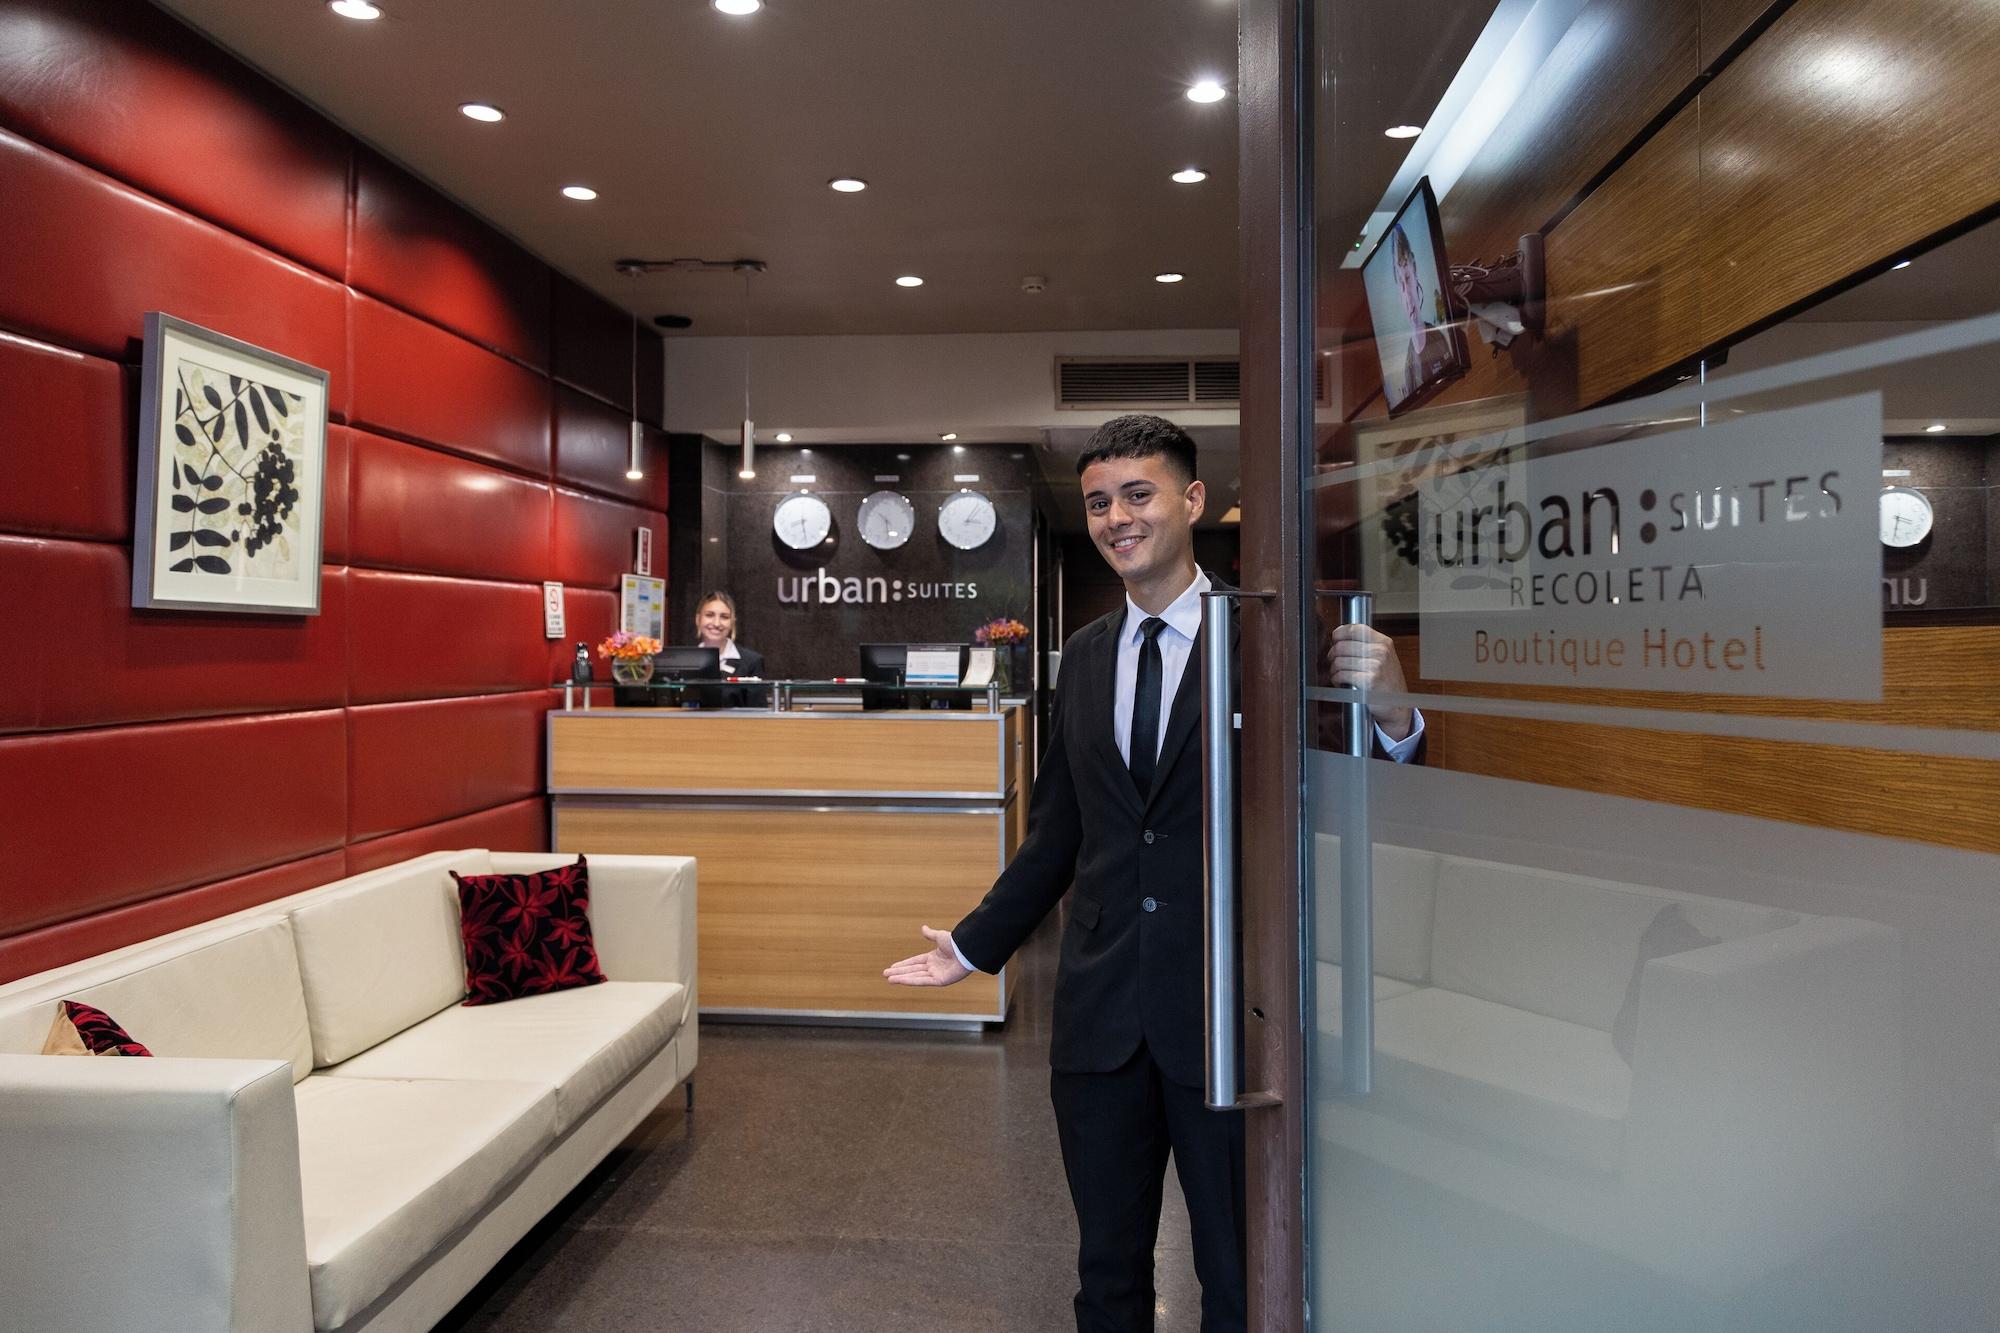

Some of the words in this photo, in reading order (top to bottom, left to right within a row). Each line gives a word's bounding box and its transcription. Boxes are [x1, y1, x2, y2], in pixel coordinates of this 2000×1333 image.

[1669, 470, 1842, 532] SUITES
[907, 582, 978, 599] SUITES
[1510, 564, 1705, 607] RECOLETA
[1474, 629, 1626, 676] Boutique
[1643, 626, 1766, 670] Hotel
